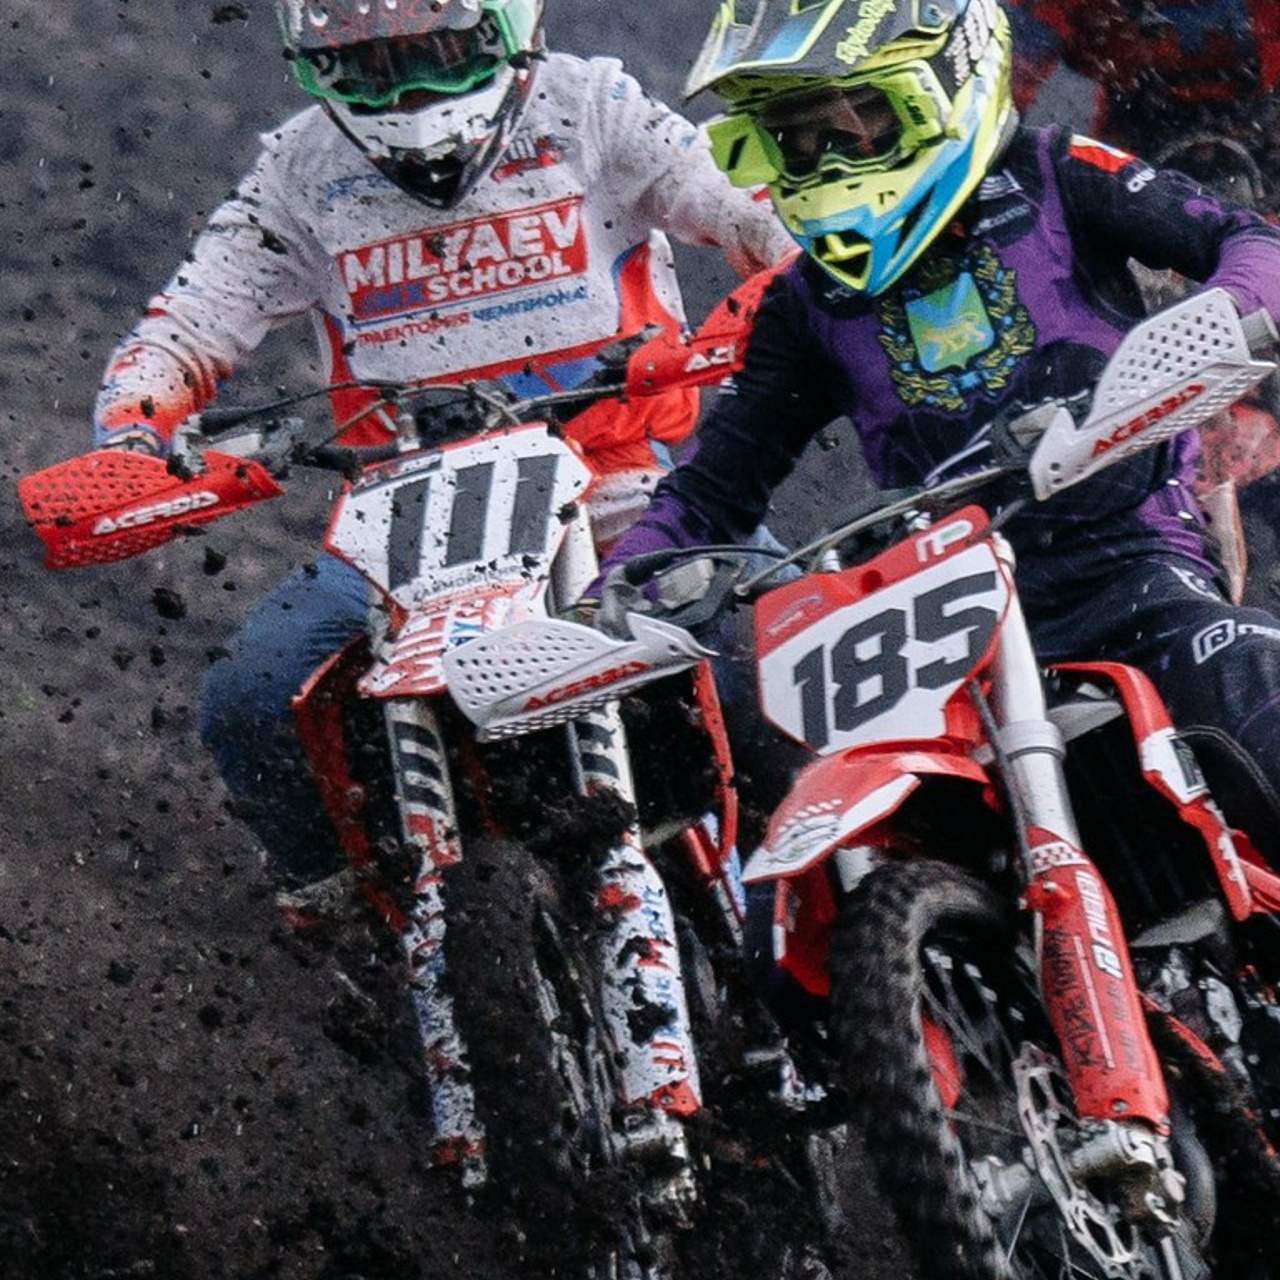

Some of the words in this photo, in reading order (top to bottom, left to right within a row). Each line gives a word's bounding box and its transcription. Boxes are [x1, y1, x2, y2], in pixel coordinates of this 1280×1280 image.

[345, 208, 580, 293] MILYAEV
[427, 252, 571, 301] SCHOOL
[387, 454, 560, 590] 111
[793, 570, 998, 750] 185
